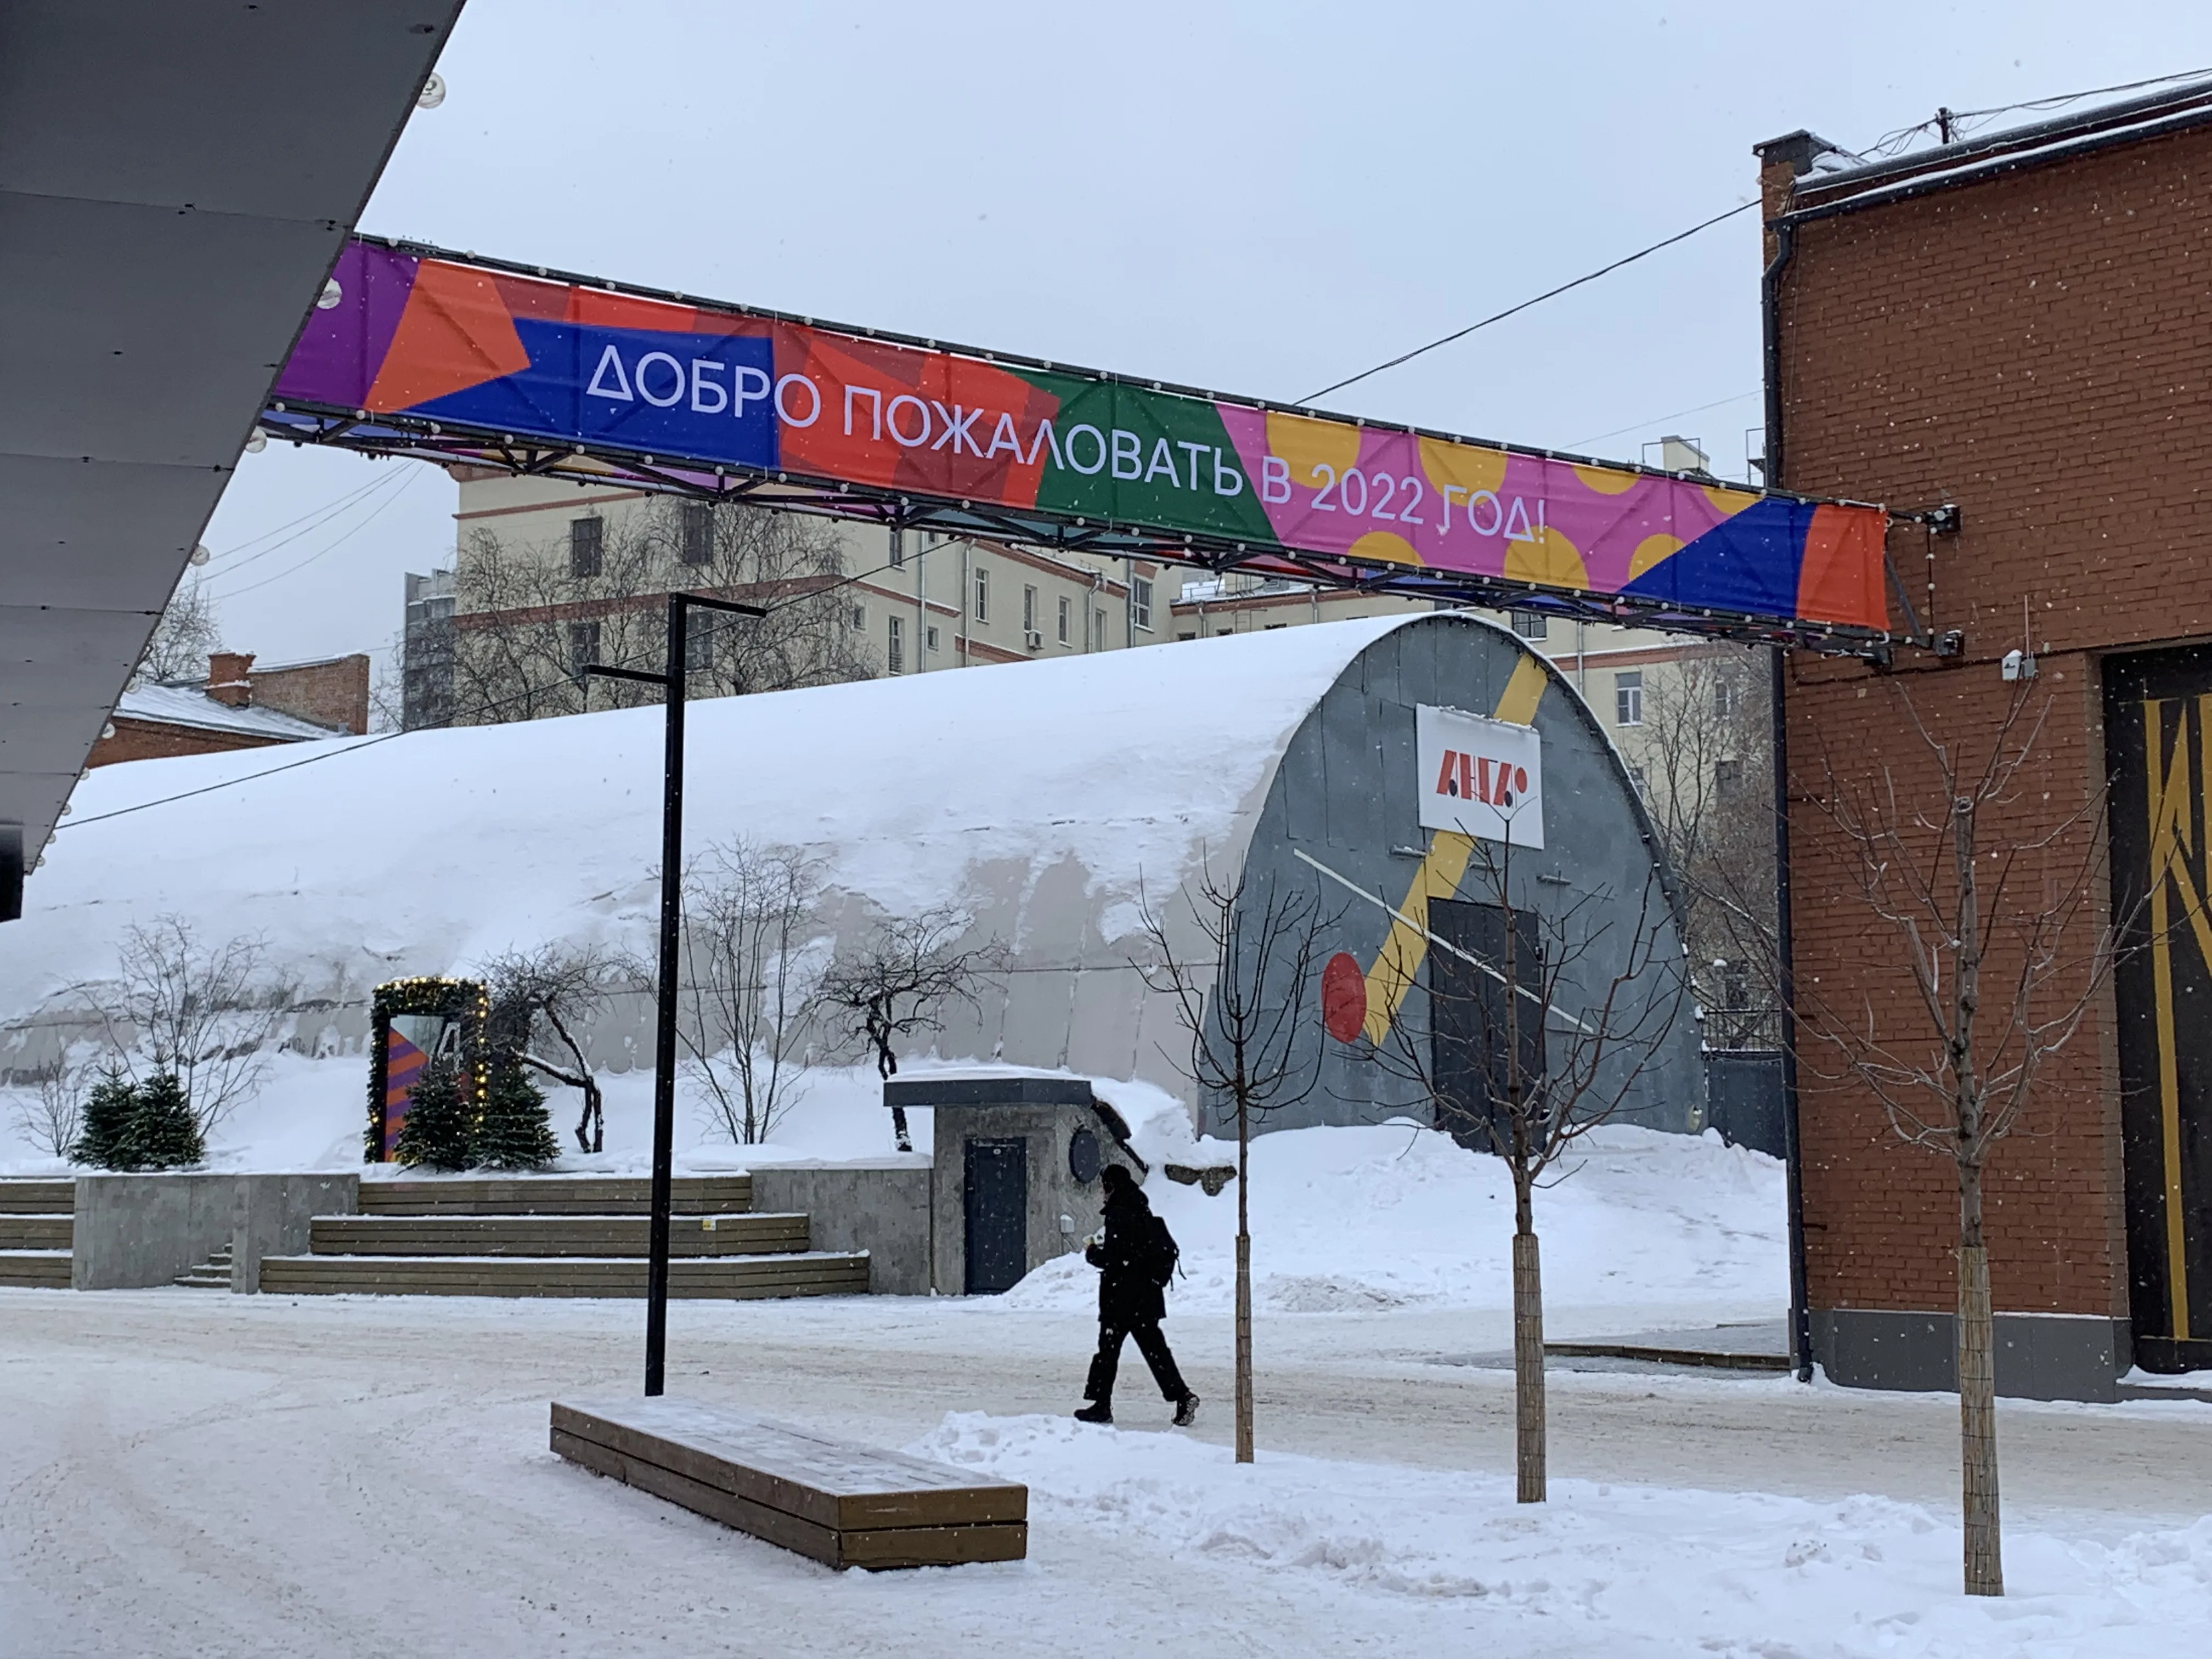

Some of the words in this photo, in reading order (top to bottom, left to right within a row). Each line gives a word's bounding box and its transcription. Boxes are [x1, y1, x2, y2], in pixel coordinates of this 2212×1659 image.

[586, 344, 821, 427] ДОБРО
[844, 385, 1243, 496] ПОЖАЛОВАТЬ
[1262, 455, 1291, 504] В
[1311, 464, 1424, 525] 2022
[1443, 484, 1545, 544] ГОД!
